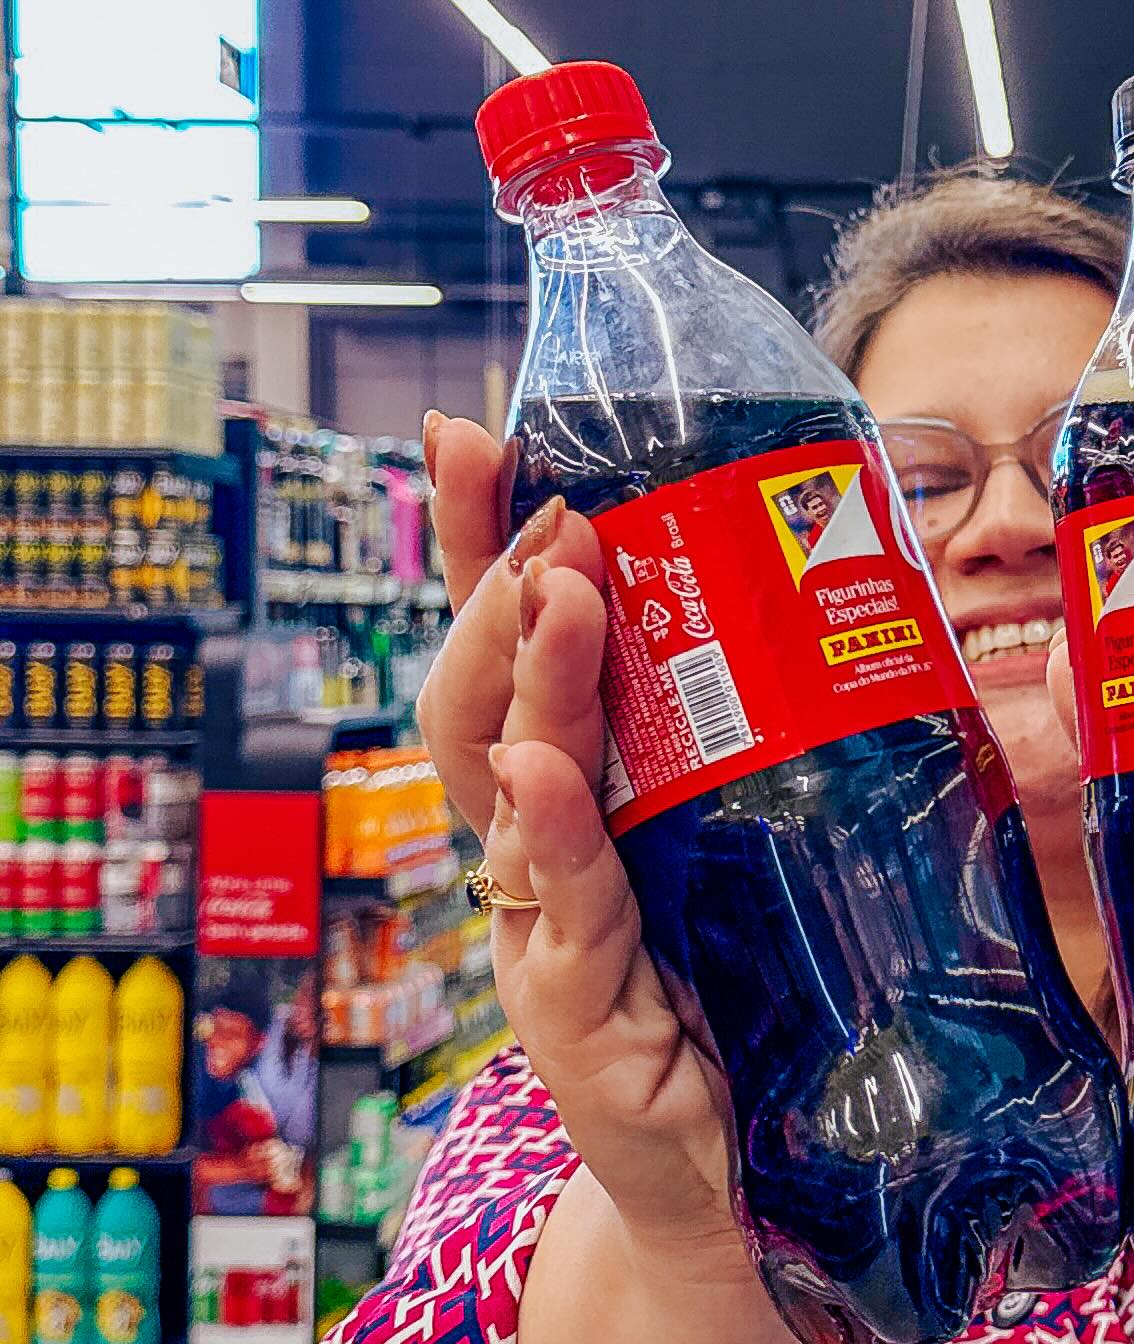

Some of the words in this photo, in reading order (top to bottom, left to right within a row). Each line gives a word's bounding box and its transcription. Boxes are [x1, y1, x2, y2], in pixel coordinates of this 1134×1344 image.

[661, 512, 684, 549] Brasil
[660, 555, 715, 639] Coca-Cola
[815, 577, 894, 606] Figurinhas
[825, 595, 900, 625] Especiais!
[829, 624, 917, 658] PANINI
[656, 660, 703, 770] RECICLE-ME
